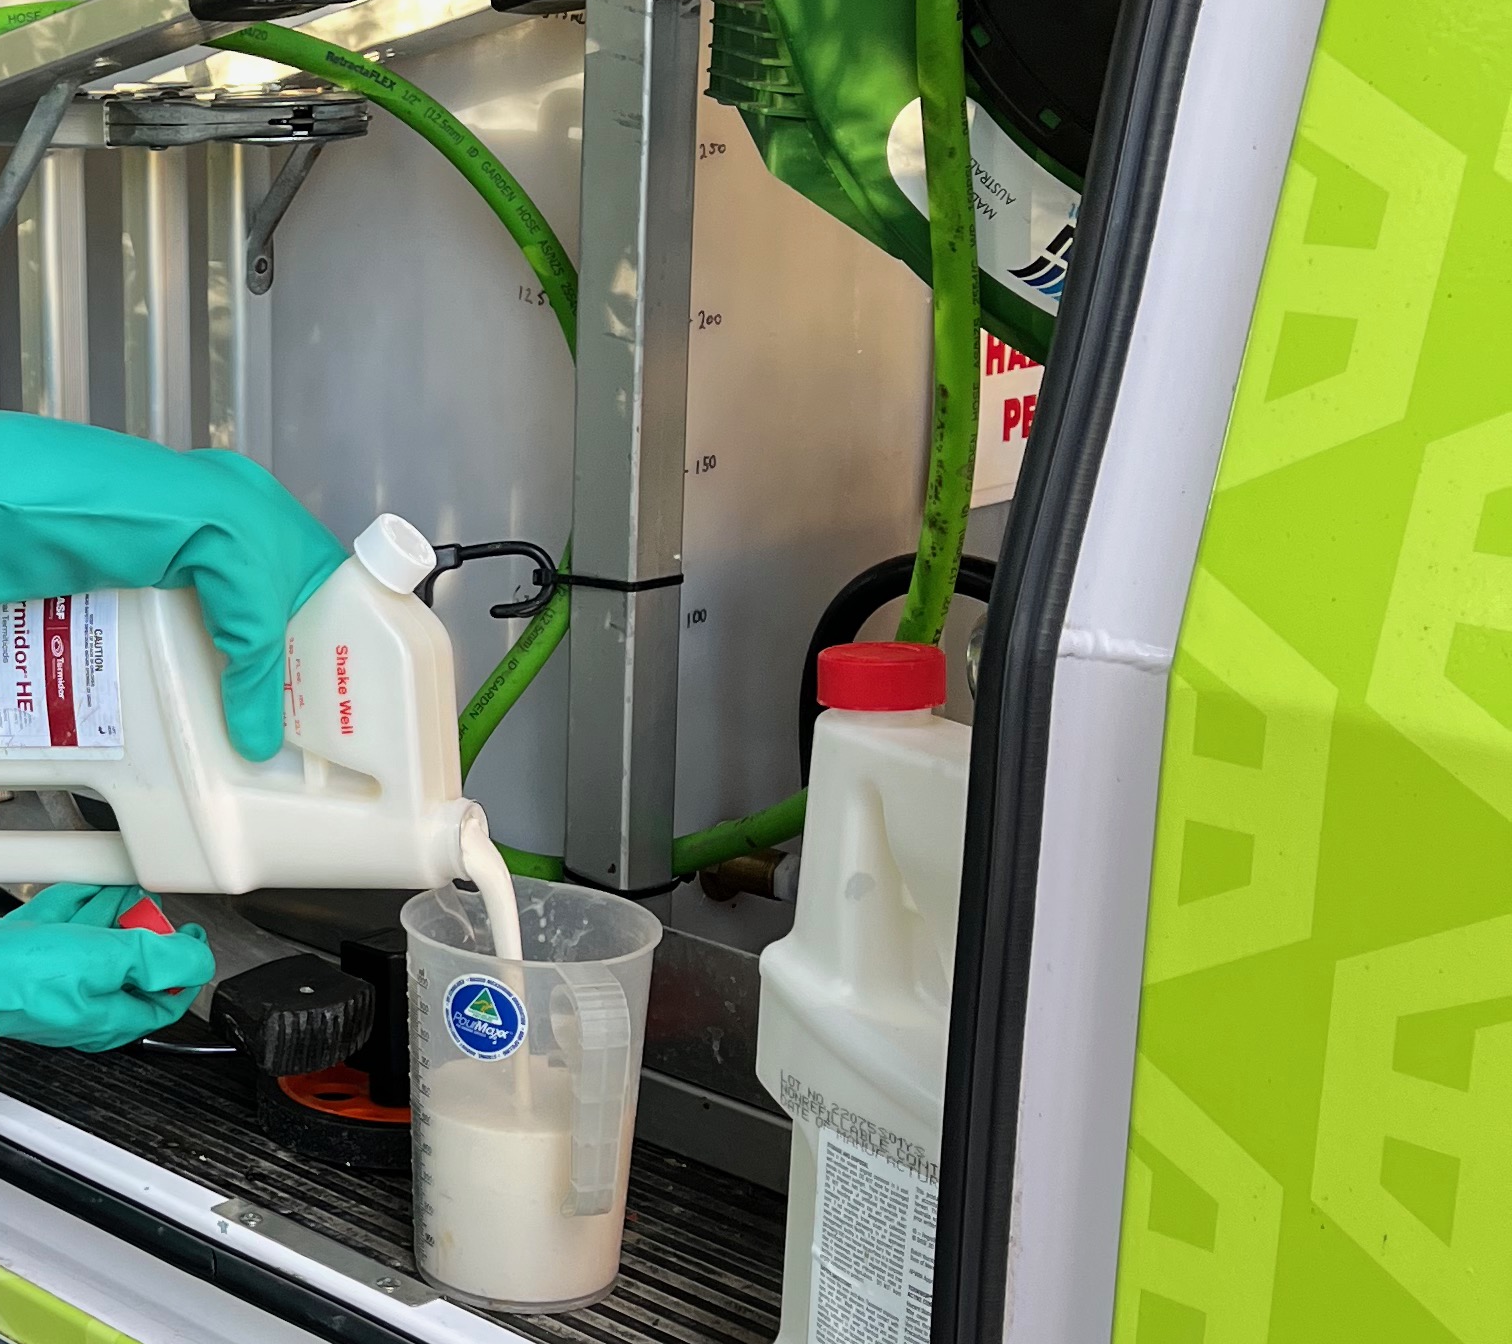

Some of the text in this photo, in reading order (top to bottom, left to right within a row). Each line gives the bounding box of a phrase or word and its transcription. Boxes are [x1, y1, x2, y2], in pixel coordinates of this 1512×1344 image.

[325, 50, 398, 92] RetractaFLEX
[466, 144, 480, 159] ID
[481, 160, 517, 203] GARDEN
[514, 205, 541, 236] HOSE
[700, 142, 727, 160] 250
[518, 285, 547, 306] 125
[698, 309, 722, 330] 200
[986, 334, 1039, 376] HA
[695, 454, 717, 475] 150
[687, 608, 707, 629] 100
[94, 629, 103, 671] CAUTION
[56, 657, 65, 700] Termidor
[336, 645, 354, 735] Shake Well
[16, 681, 33, 712] HE
